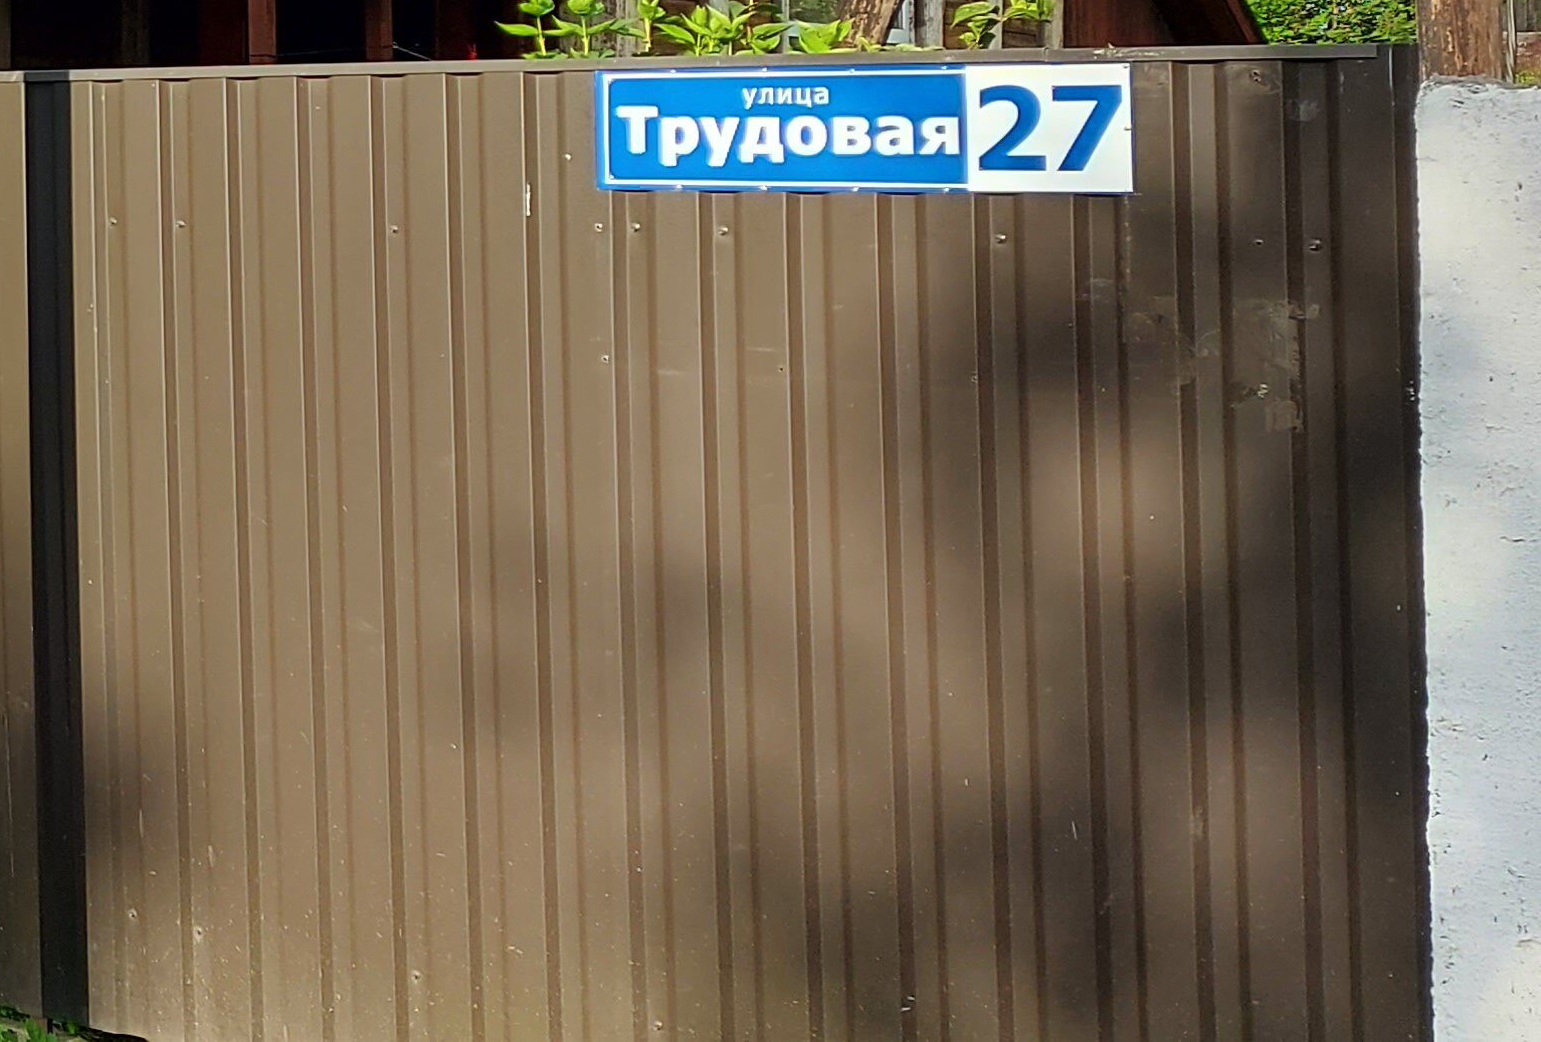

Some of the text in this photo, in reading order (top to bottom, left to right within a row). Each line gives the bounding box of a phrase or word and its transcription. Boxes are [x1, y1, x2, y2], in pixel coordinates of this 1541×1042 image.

[742, 86, 830, 110] улица
[616, 84, 1123, 172] Трудовая 27
